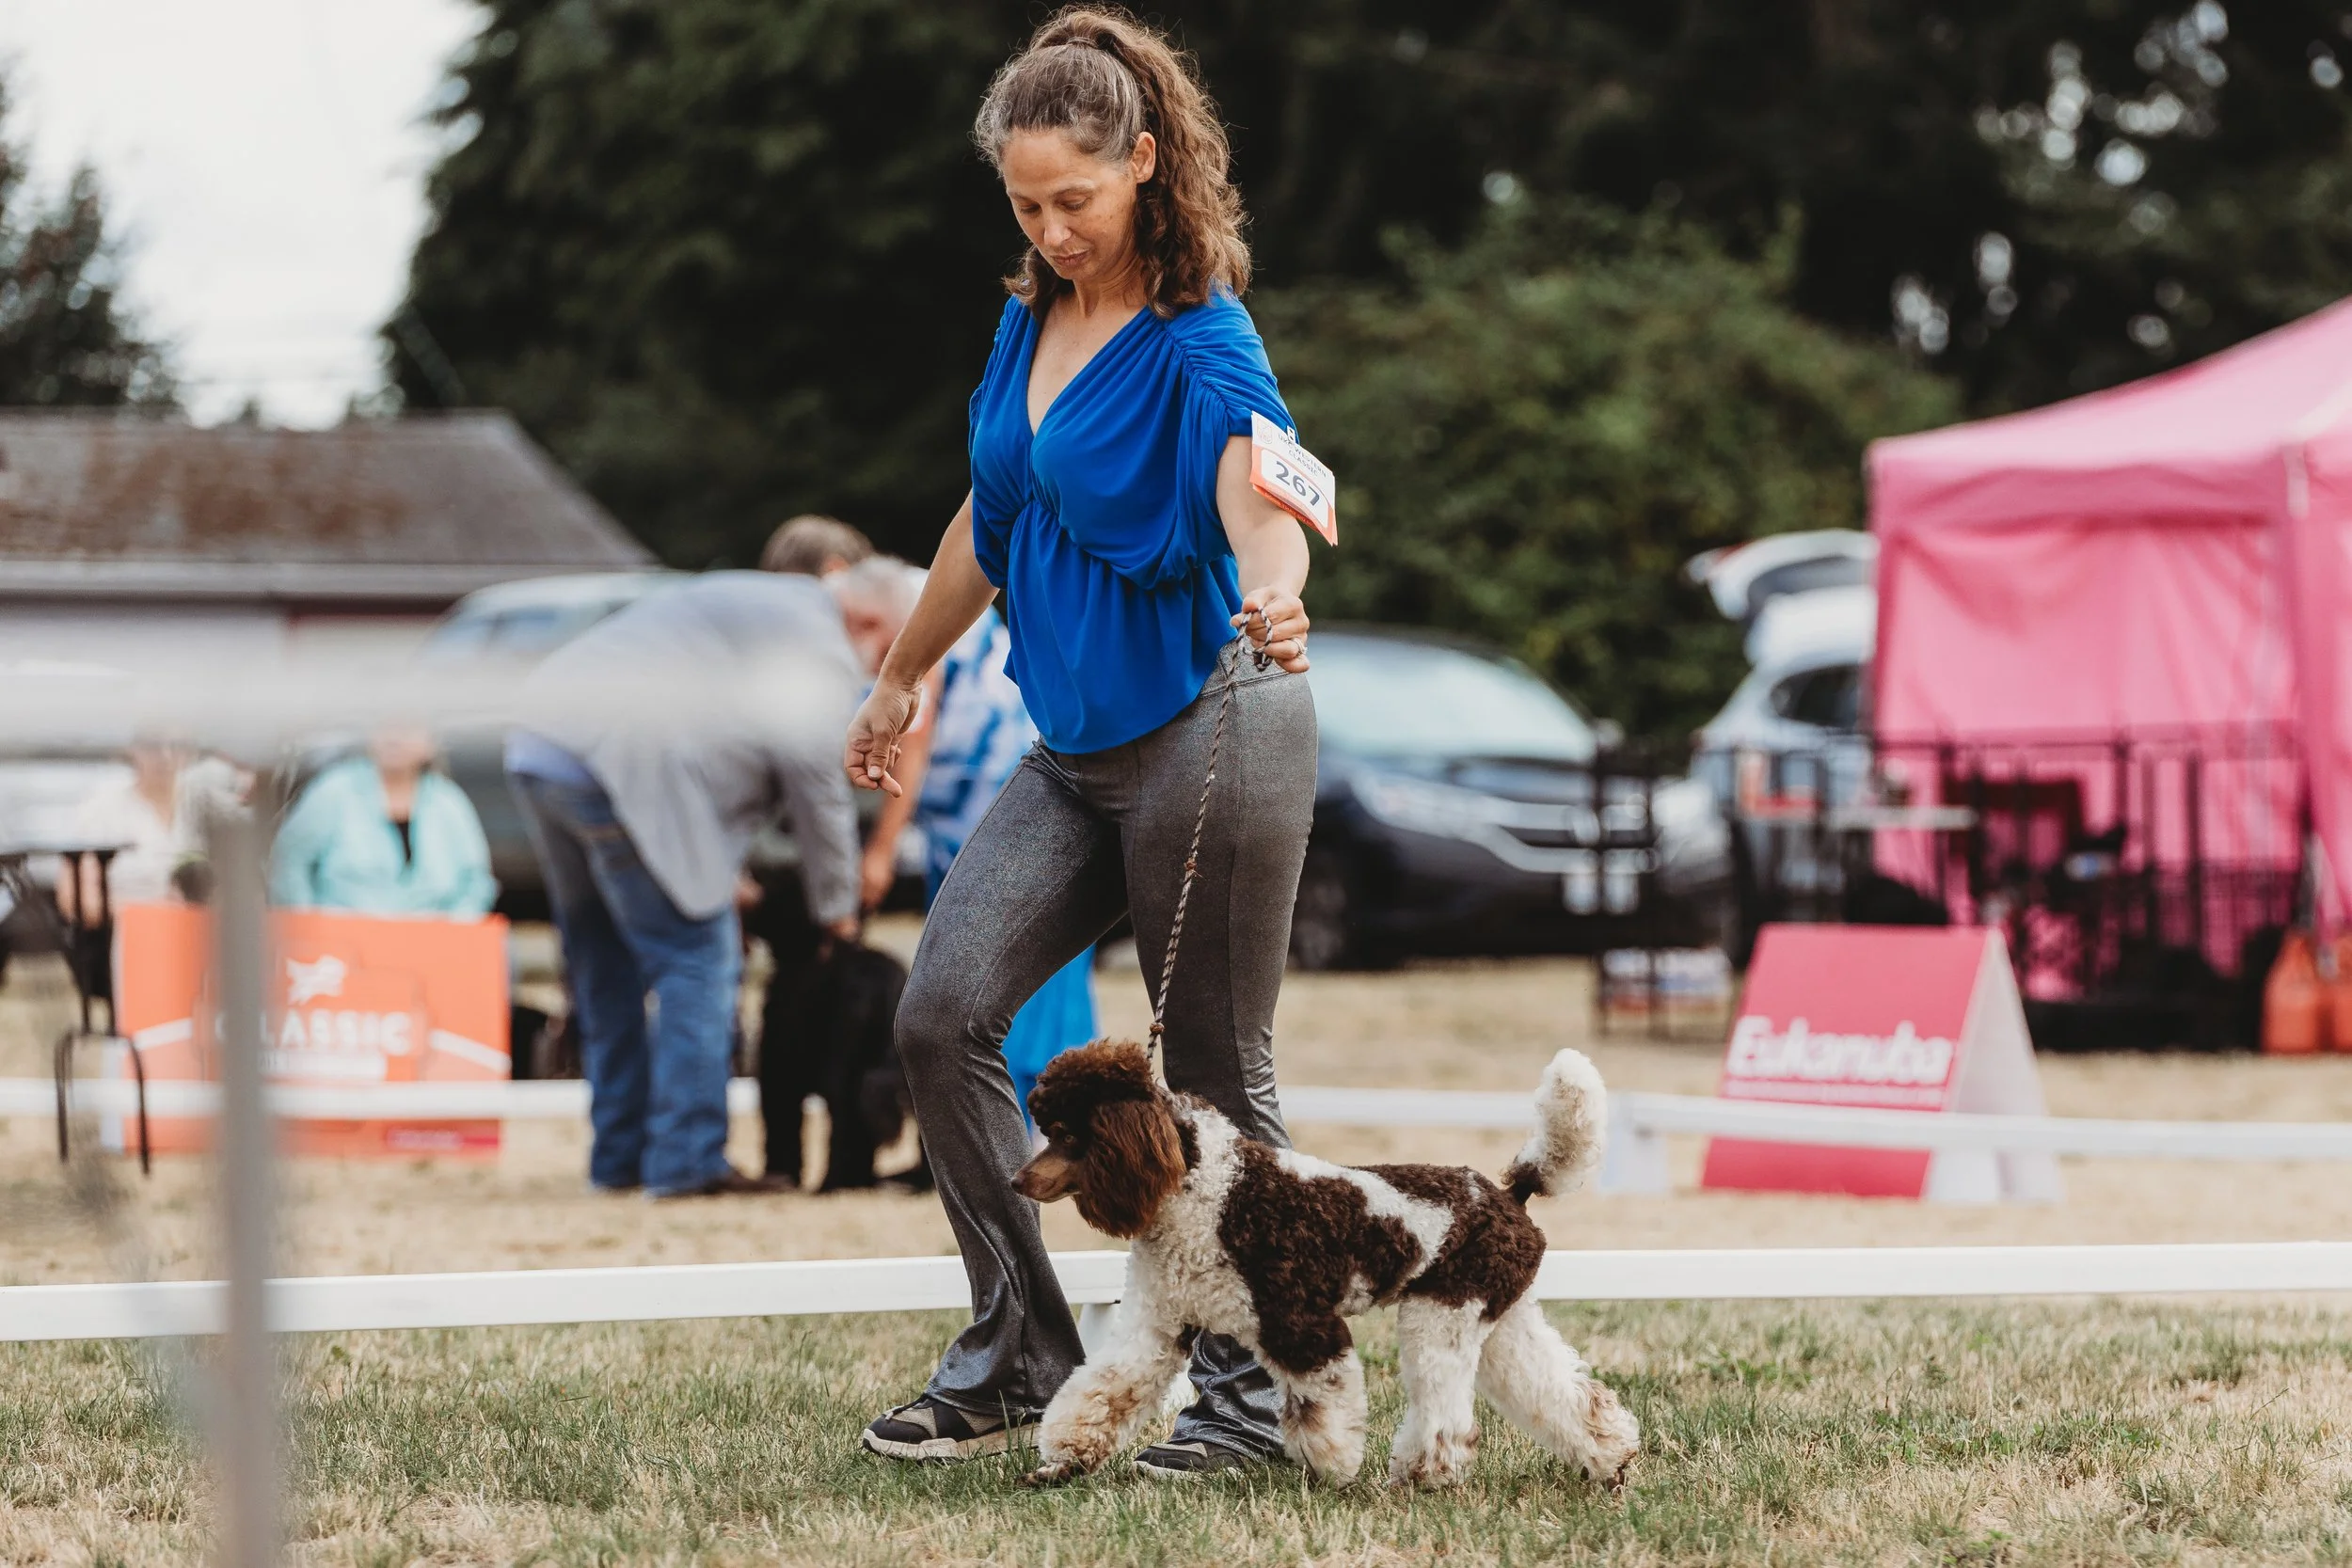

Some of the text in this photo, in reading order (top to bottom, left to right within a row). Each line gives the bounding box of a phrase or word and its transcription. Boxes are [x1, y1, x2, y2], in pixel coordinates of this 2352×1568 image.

[1288, 449, 1318, 477] CLASSIC
[1295, 447, 1327, 478] WESTERN
[1276, 461, 1320, 506] 267
[1727, 1015, 1953, 1085] Eukanuba
